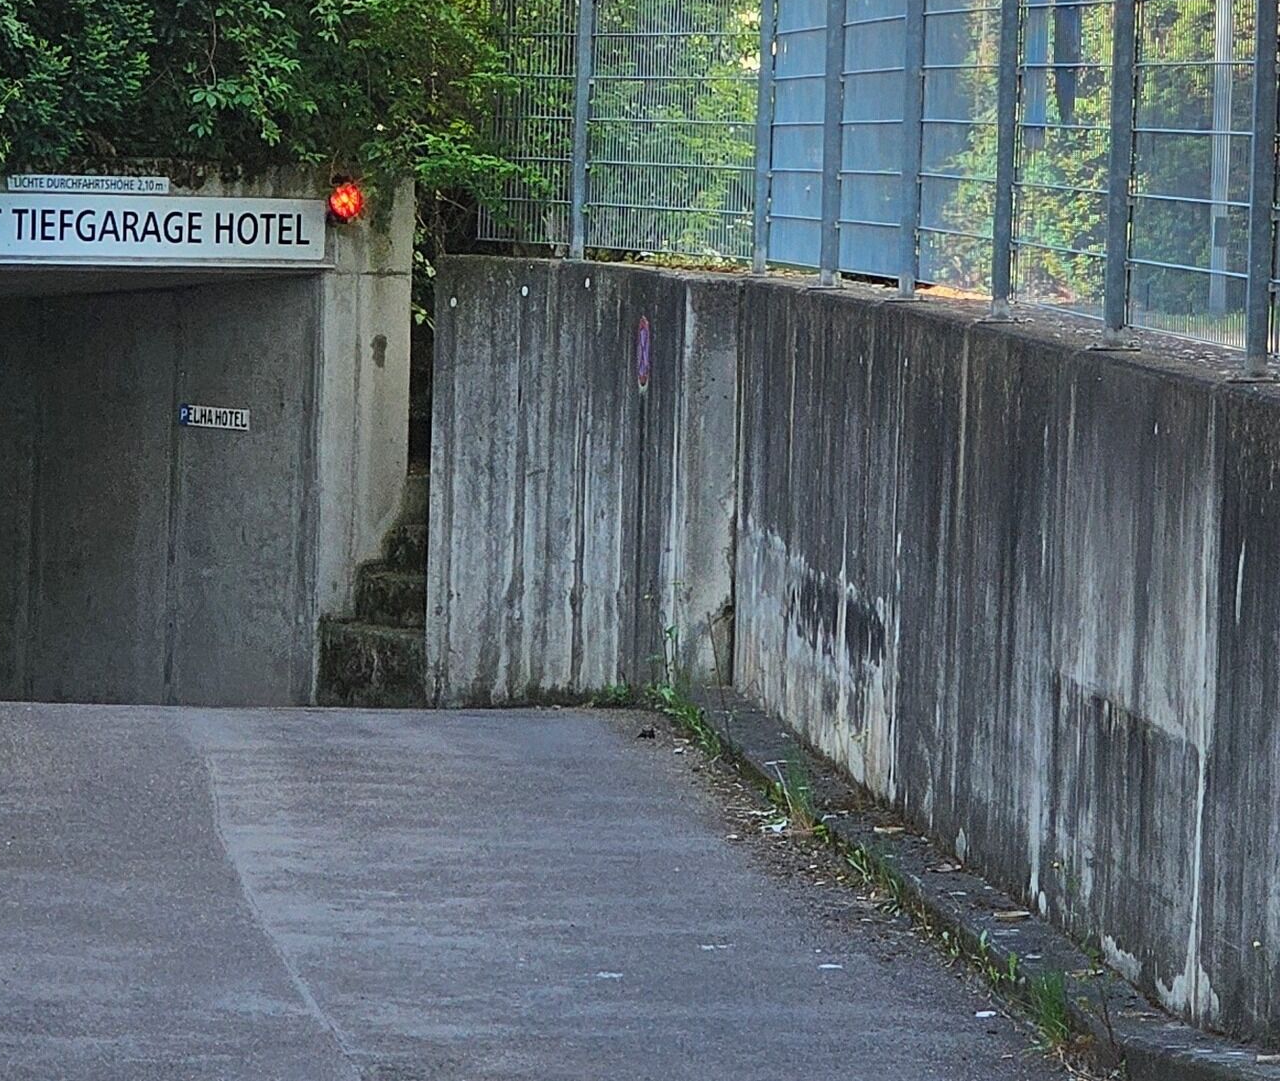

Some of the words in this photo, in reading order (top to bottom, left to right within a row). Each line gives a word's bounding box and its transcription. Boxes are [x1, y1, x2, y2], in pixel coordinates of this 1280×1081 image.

[14, 176, 44, 189] LICHTE
[155, 182, 164, 190] m
[11, 208, 203, 244] TIEFGARAGE
[215, 212, 310, 245] HOTEL
[215, 409, 247, 427] HOTEL
